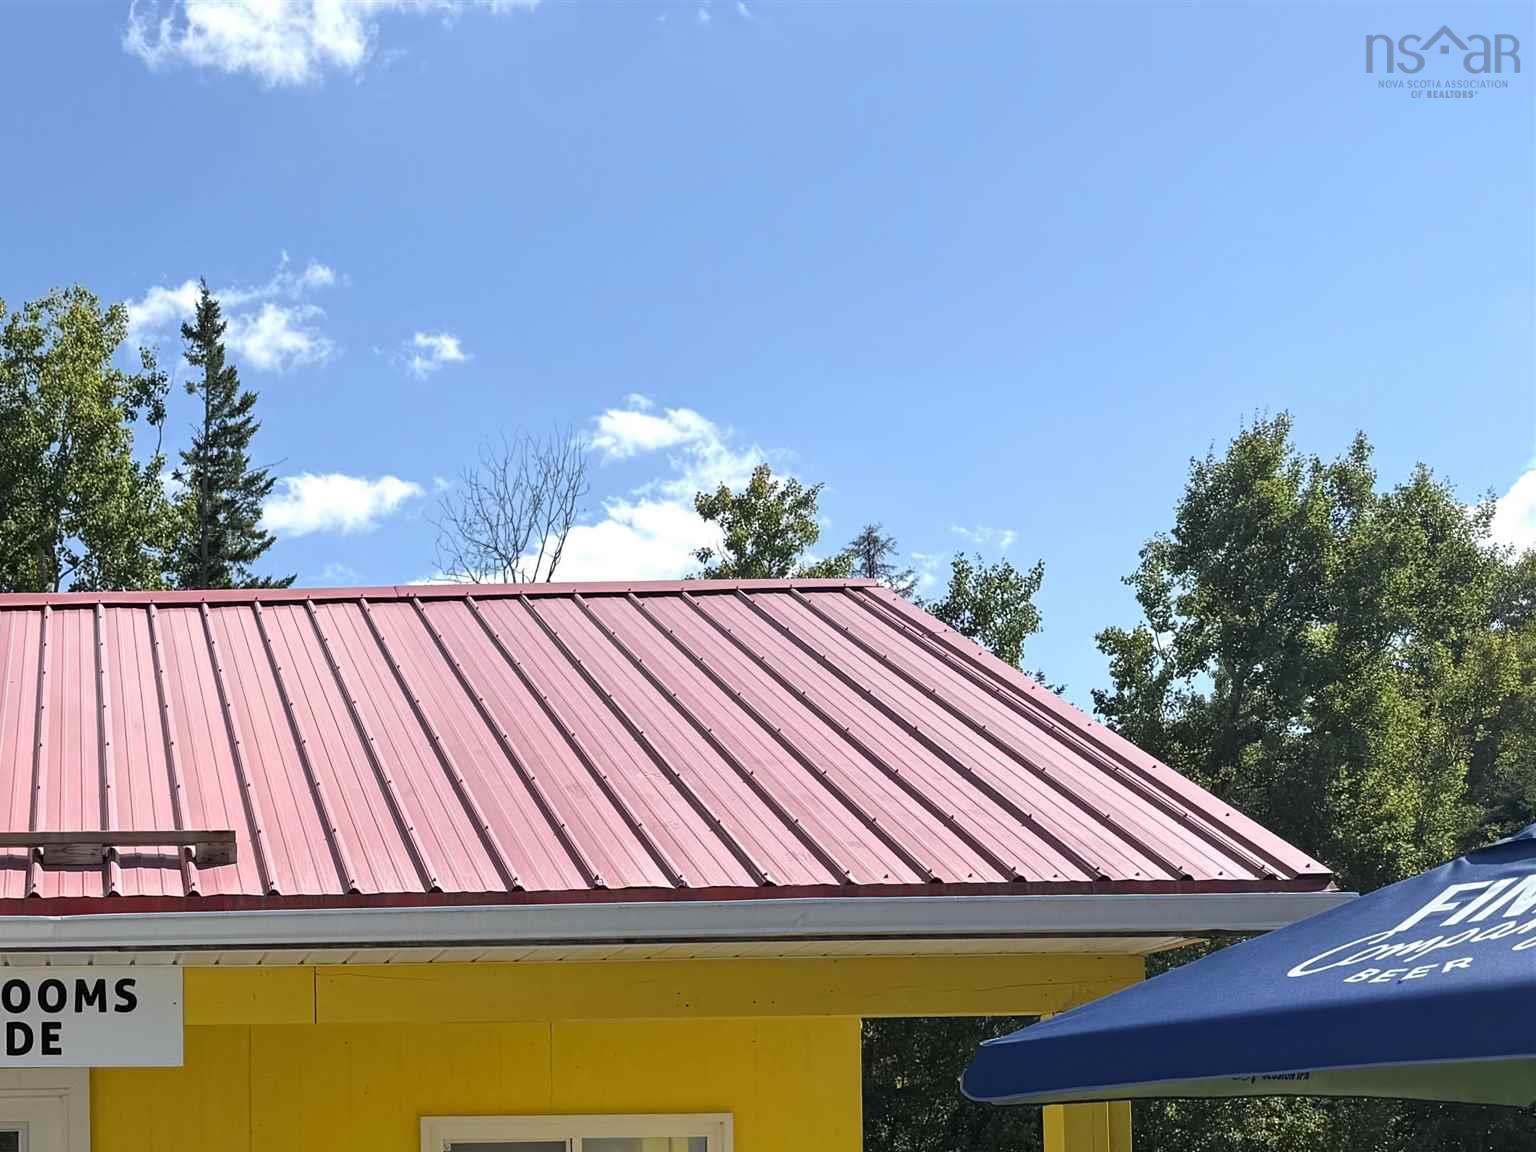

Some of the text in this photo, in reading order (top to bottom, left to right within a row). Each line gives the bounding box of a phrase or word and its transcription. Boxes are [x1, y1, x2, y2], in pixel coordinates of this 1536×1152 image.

[1393, 874, 1536, 932] FIN
[1287, 916, 1536, 978] Compa
[1343, 957, 1473, 984] BEER
